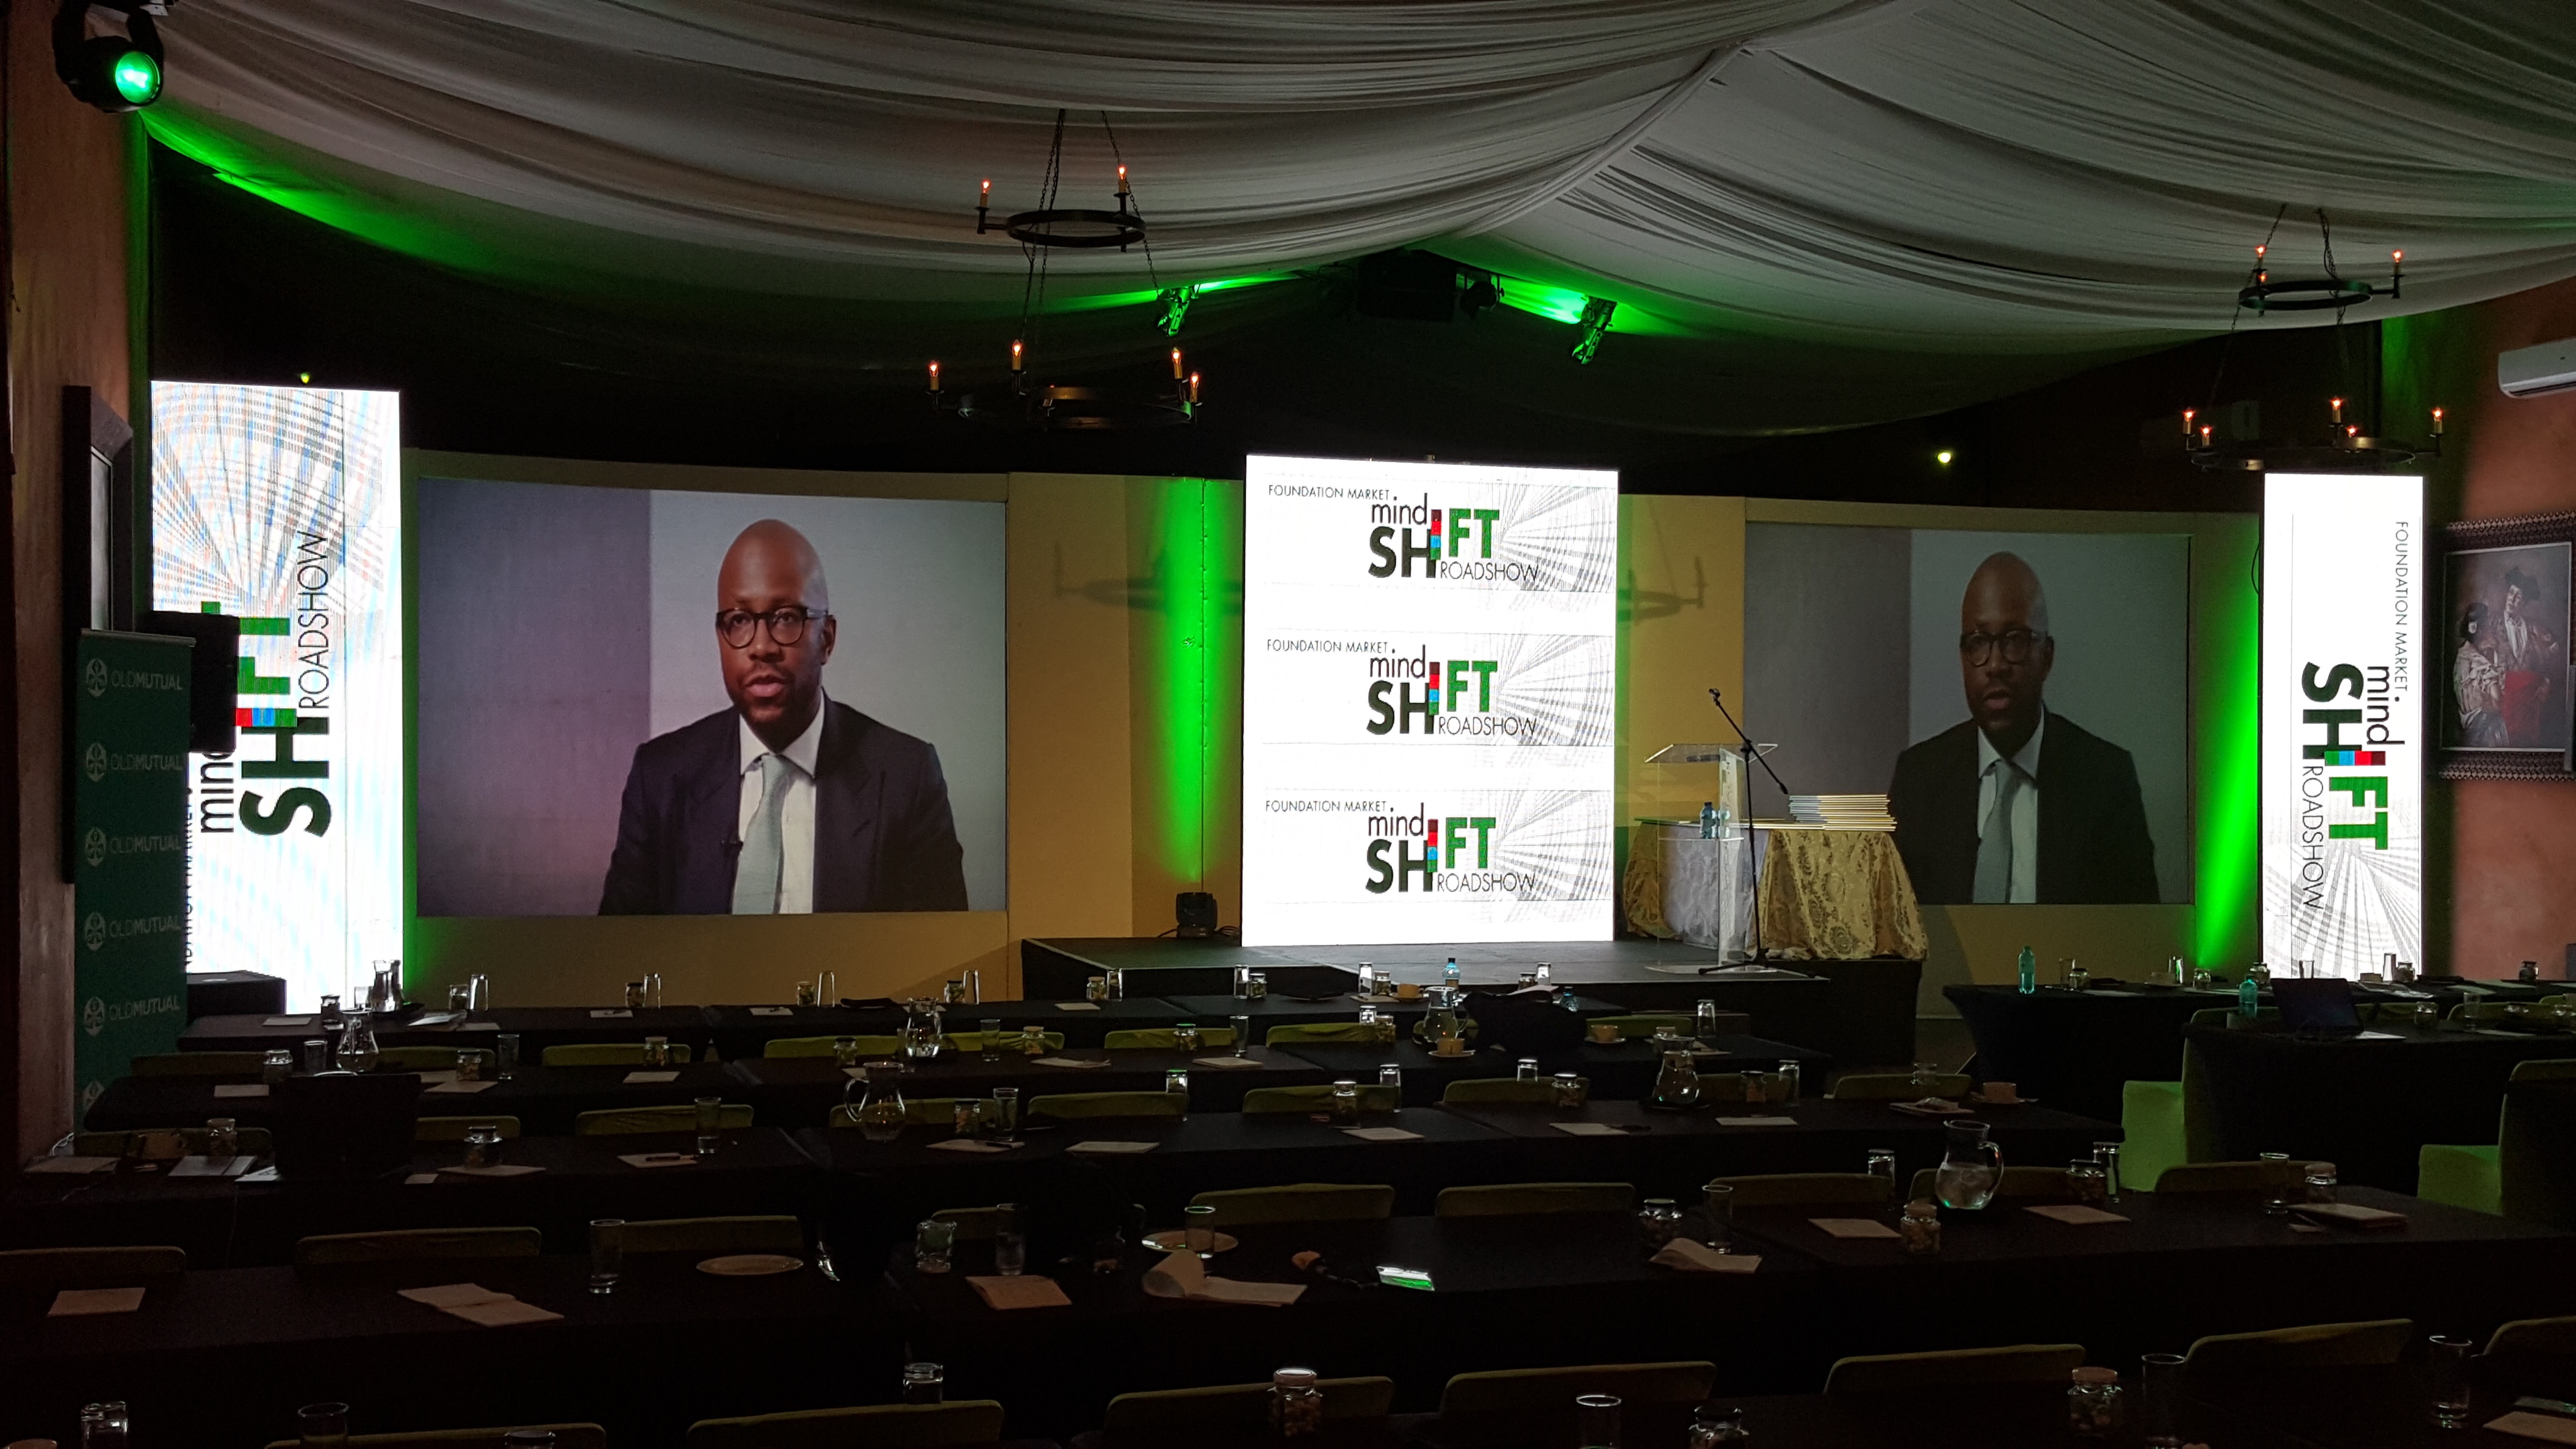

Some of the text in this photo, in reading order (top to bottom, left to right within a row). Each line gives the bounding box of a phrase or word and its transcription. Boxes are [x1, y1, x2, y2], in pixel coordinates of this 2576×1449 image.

[1268, 485, 1390, 500] FOUNDATION MARKET
[1371, 493, 1428, 524] mind
[1440, 562, 1539, 581] ROADSHOW
[298, 531, 329, 709] ROADSHOW
[2395, 521, 2408, 691] FOUNDATION MARKET
[1267, 640, 1388, 653] FOUNDATION MARKET
[1369, 645, 1426, 677] mind
[2367, 666, 2405, 744] mind
[1438, 717, 1537, 735] ROADSHOW
[1265, 800, 1387, 812] FOUNDATION MARKET
[1368, 802, 1424, 836] mind
[2302, 766, 2324, 909] ROADSHOW
[1437, 873, 1536, 892] ROADSHOW
